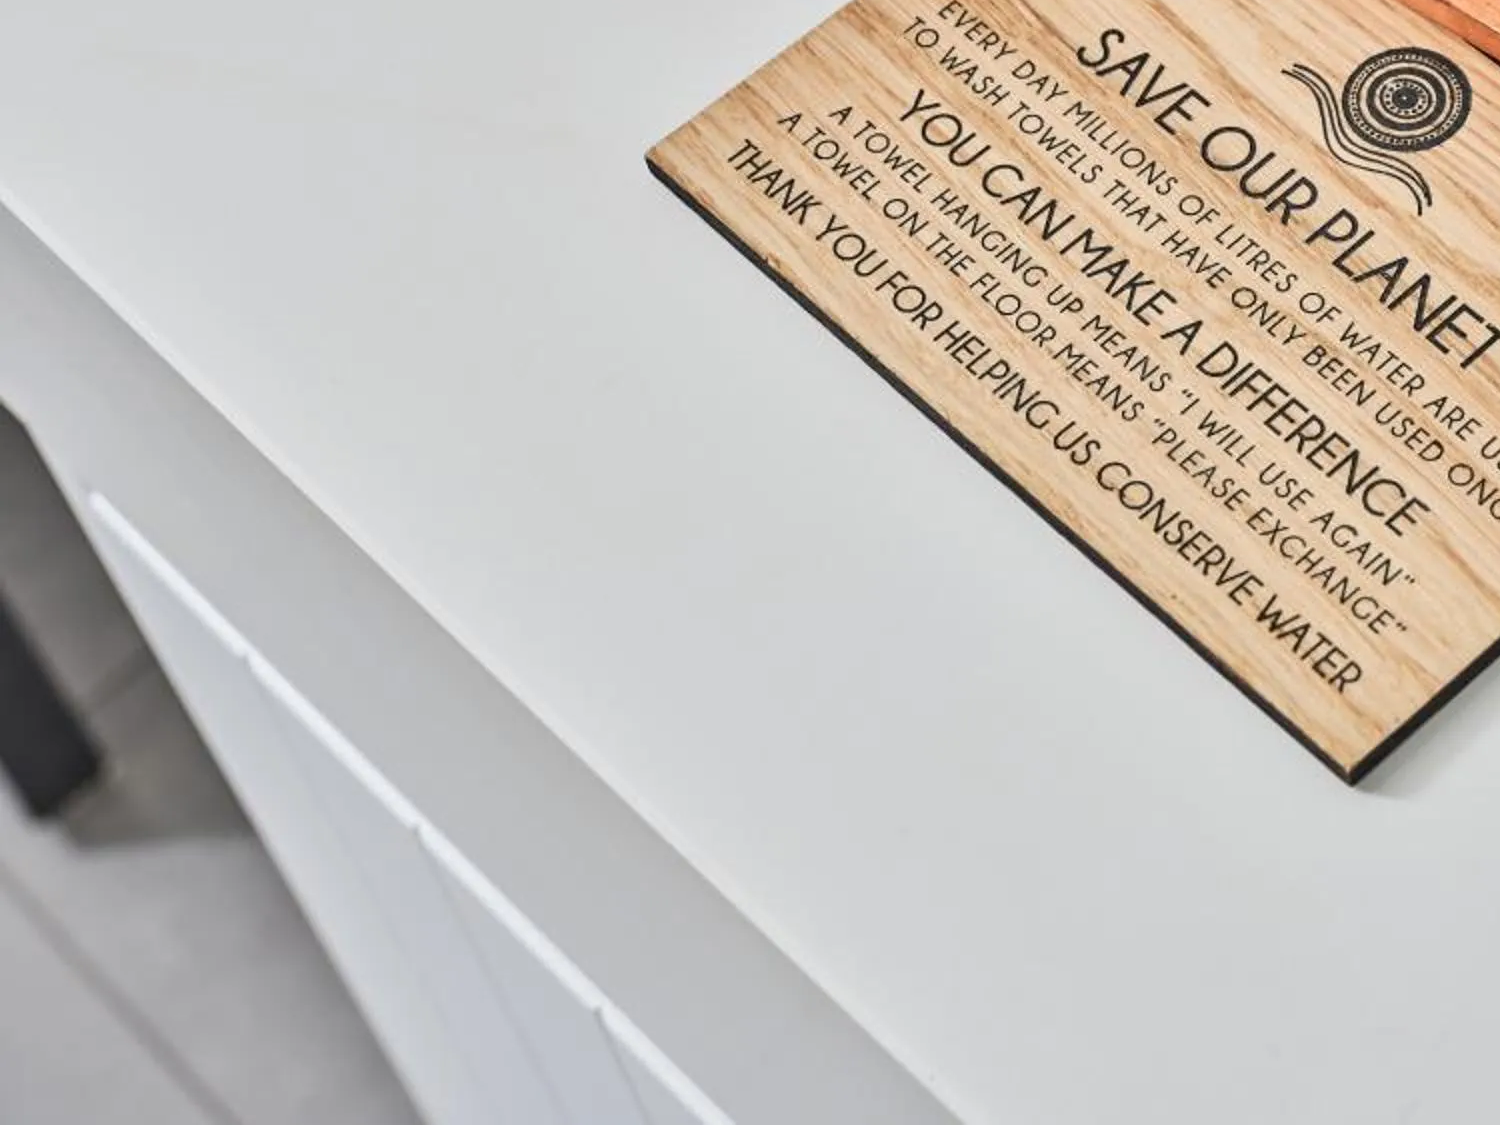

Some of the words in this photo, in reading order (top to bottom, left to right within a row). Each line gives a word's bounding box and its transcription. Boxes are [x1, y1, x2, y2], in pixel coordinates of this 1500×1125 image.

[776, 112, 803, 134] A
[800, 125, 881, 203] TOWEL
[881, 197, 930, 238] ON
[924, 230, 977, 278] THE
[967, 270, 1057, 348] FLOOR
[1050, 341, 1145, 422] MEANS
[827, 105, 853, 126] A
[852, 119, 933, 194] TOWEL
[929, 186, 1049, 288] HANGING
[1045, 283, 1084, 314] UP
[1079, 313, 1172, 393] MEANS
[1196, 408, 1256, 468] WILL
[1257, 461, 1315, 512] USE
[898, 87, 992, 168] YOU
[980, 163, 1076, 242] CAN
[1057, 226, 1178, 327] MAKE
[1158, 318, 1204, 356] A
[1194, 339, 1431, 537] DIFFERENCE
[902, 14, 940, 49] TO
[938, 44, 1011, 107] WASH
[1006, 99, 1104, 184] TOWELS
[1102, 177, 1168, 233] THAT
[1159, 228, 1233, 290] HAVE
[1230, 285, 1307, 345] ONLY
[1300, 343, 1377, 407] BEEN
[1374, 400, 1445, 462] USED
[1010, 58, 1069, 102] DAY
[1061, 100, 1179, 196] MILLIONS
[1176, 193, 1221, 226] OF
[1213, 222, 1299, 293] LITRES
[1298, 291, 1342, 323] OF
[1338, 320, 1426, 398] WATER
[1421, 395, 1483, 442] ARE
[1075, 27, 1213, 137] SAVE
[1199, 125, 1319, 227] OUR
[726, 137, 823, 226] THANK
[814, 212, 889, 278] YOU
[873, 269, 944, 331] FOR
[932, 319, 1061, 430] HELPING
[1052, 419, 1102, 466] US
[1094, 460, 1265, 607] CONSERVE
[1254, 592, 1363, 695] WATER
